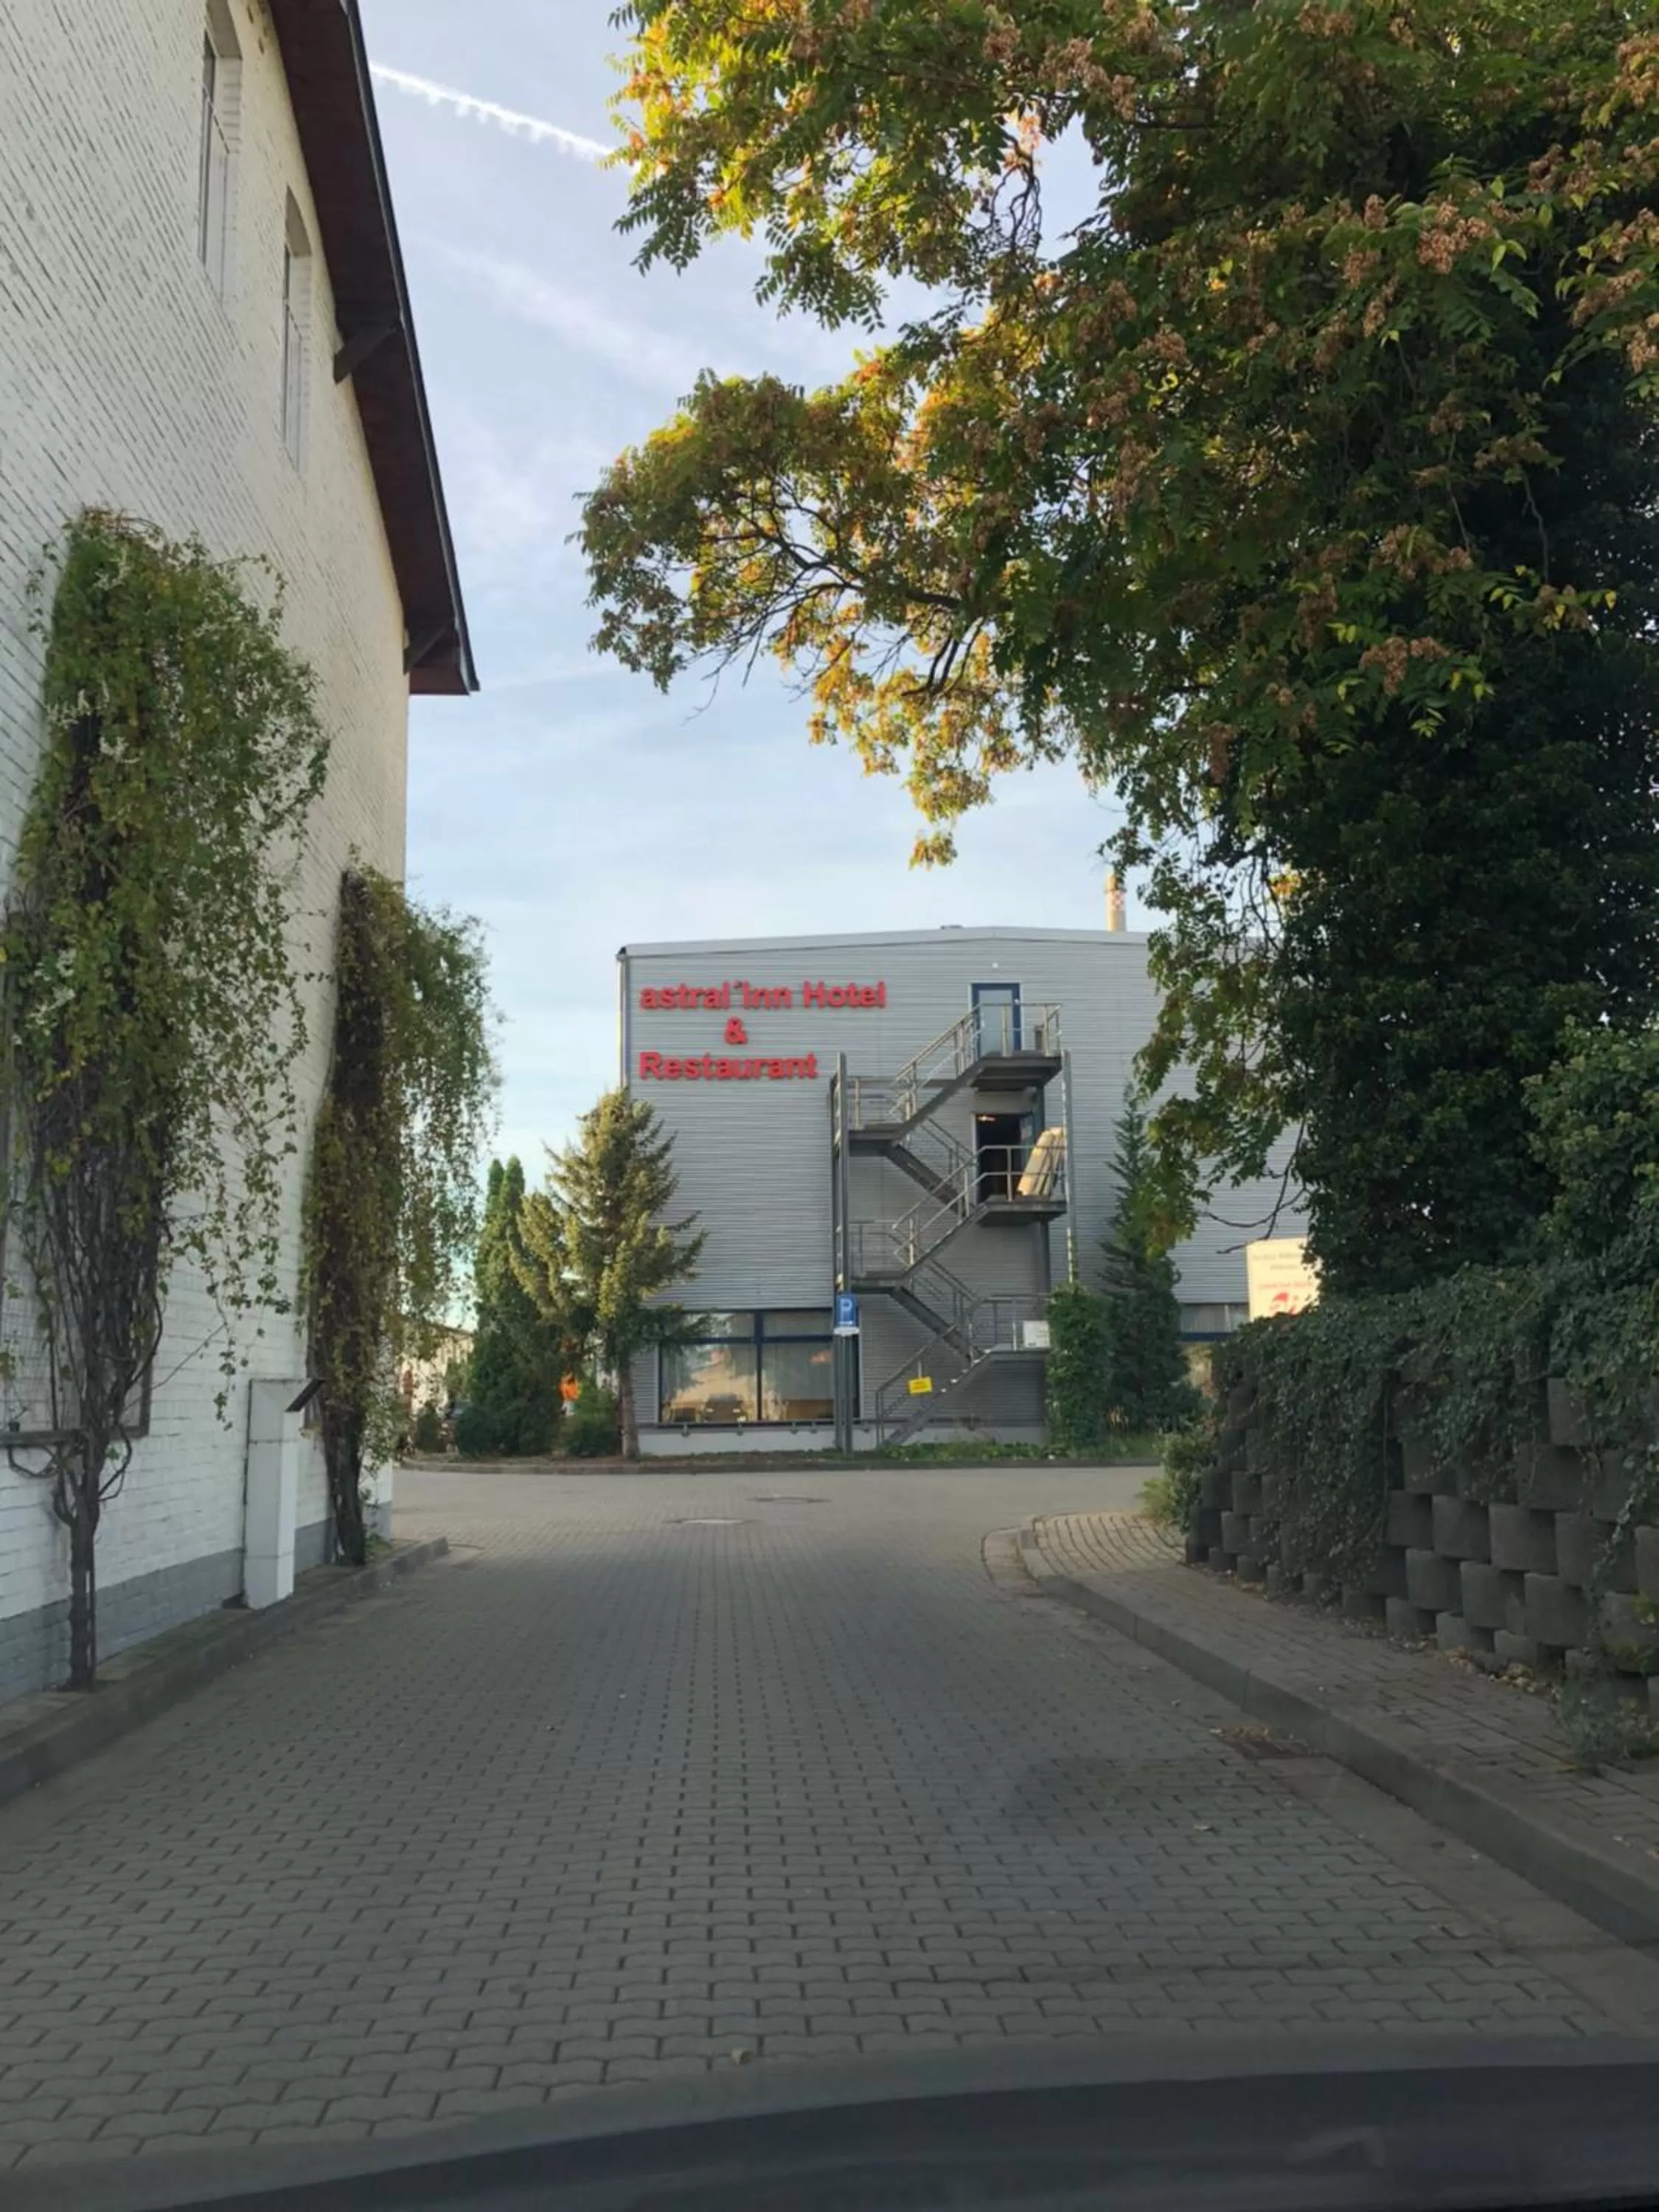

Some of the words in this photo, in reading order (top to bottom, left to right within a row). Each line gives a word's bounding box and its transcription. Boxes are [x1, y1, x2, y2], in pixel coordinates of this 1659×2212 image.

[802, 981, 886, 1009] Hotel
[723, 1015, 748, 1045] &
[639, 1050, 818, 1080] Restaurant
[840, 1298, 853, 1321] P
